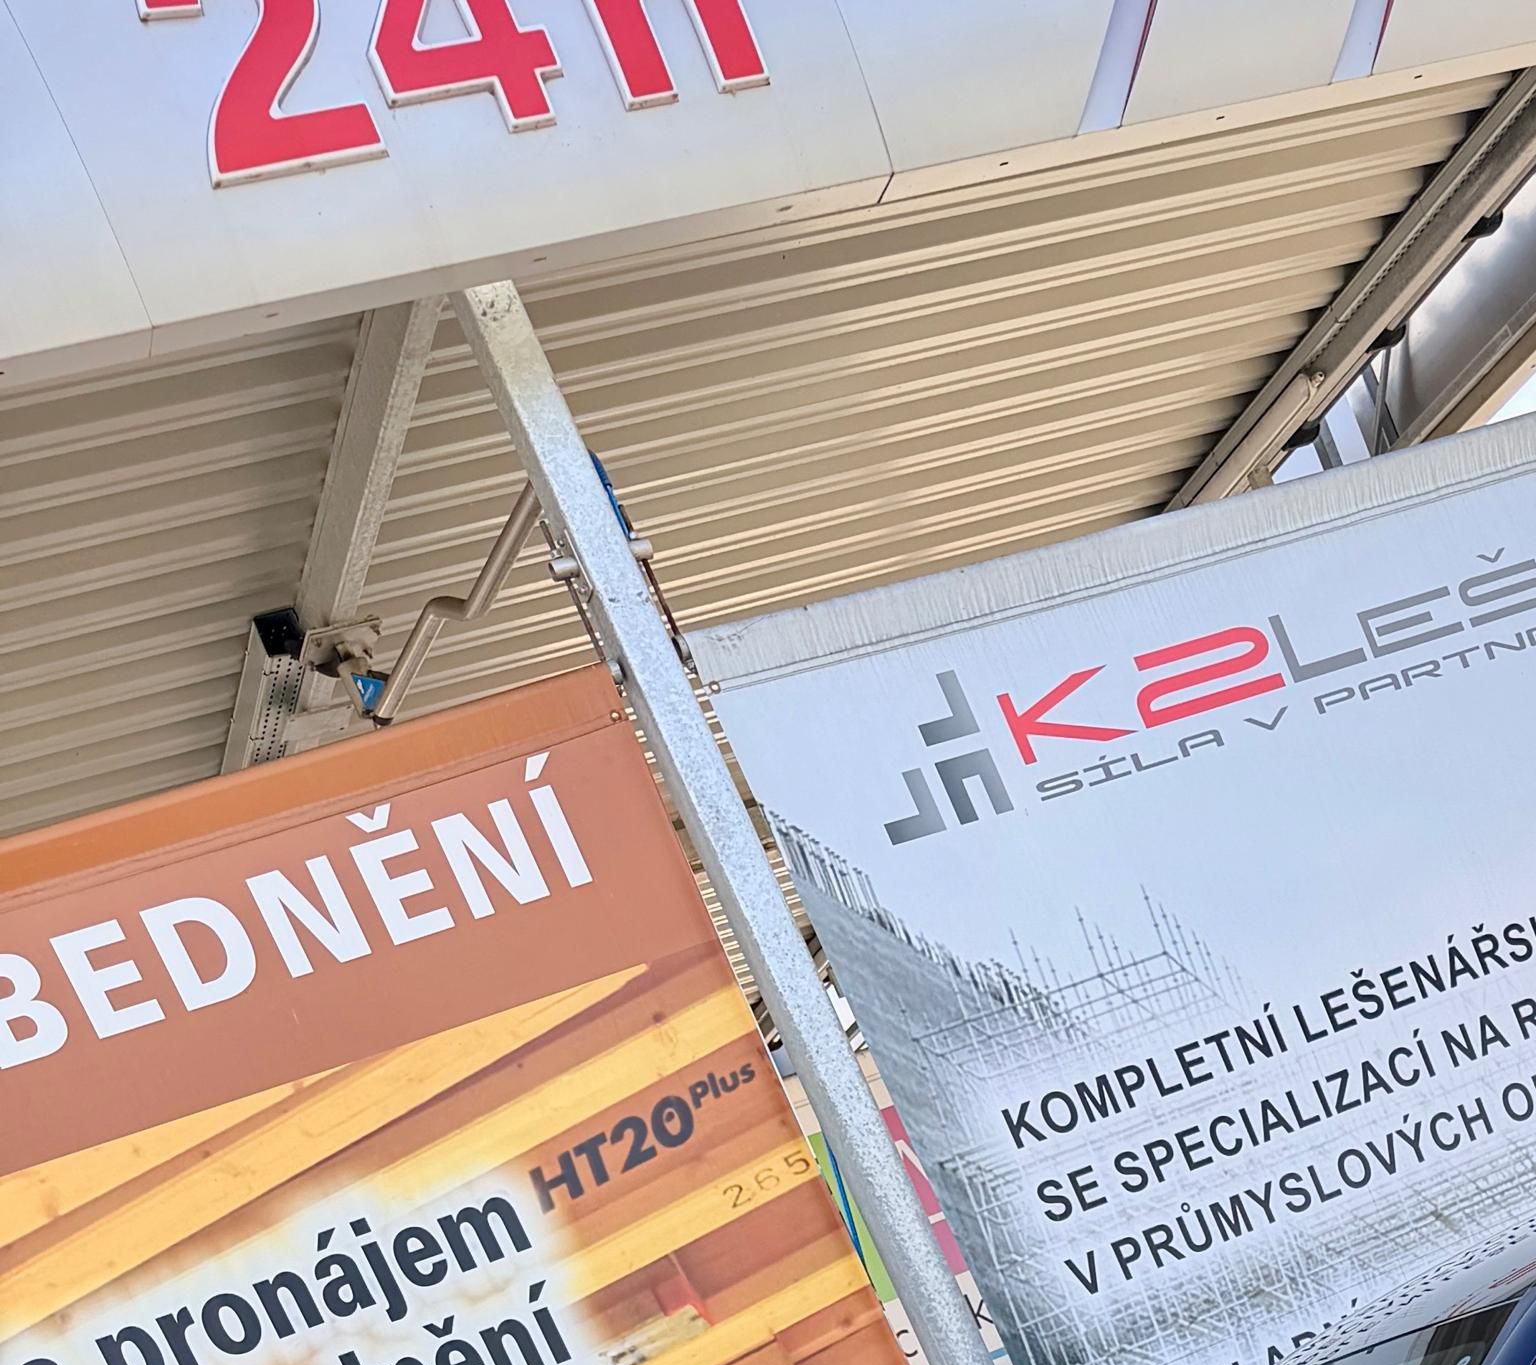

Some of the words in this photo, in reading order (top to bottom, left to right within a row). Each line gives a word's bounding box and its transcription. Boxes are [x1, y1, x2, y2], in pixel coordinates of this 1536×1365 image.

[1036, 728, 1225, 802] SÍLA
[1246, 707, 1290, 731] V
[0, 753, 594, 1071] BEDNĚNÍ
[1002, 1003, 1289, 1148] KOMPLETNÍ
[1035, 1163, 1107, 1222] SE
[1115, 1030, 1443, 1195] SPECIALIZACÍ
[1443, 1014, 1510, 1077] NA
[1064, 1249, 1099, 1294] V
[1111, 1096, 1493, 1281] PRŮMYSLOVÝCH
